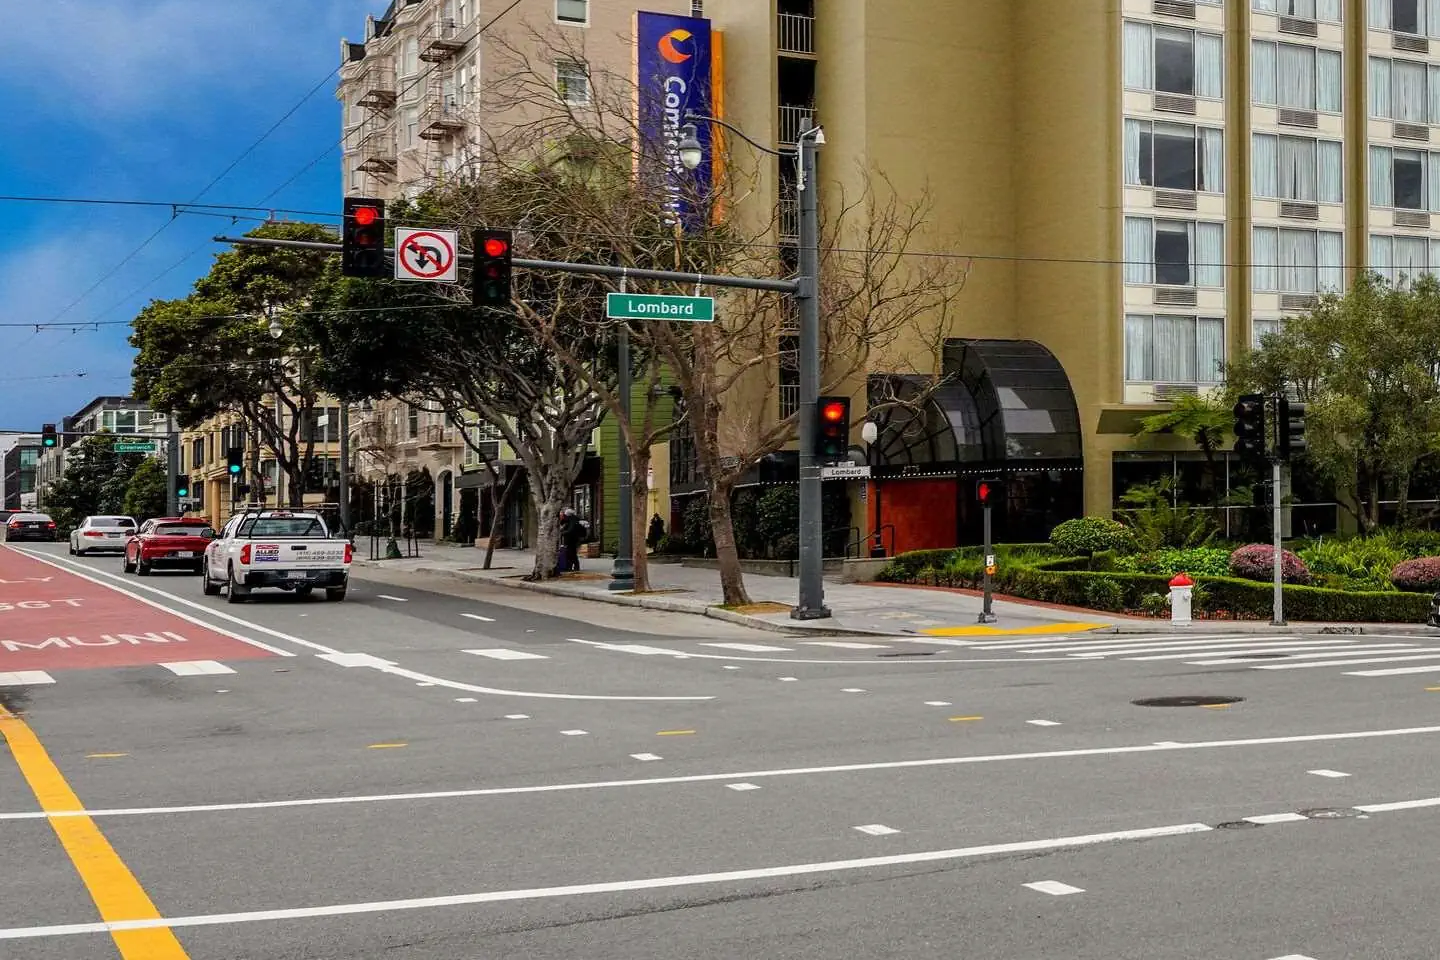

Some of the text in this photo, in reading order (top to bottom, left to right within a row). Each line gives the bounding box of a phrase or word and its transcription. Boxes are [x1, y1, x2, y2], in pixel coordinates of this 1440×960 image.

[628, 300, 694, 315] Lombard
[831, 468, 862, 476] Lombard
[1, 632, 188, 651] MUNI
